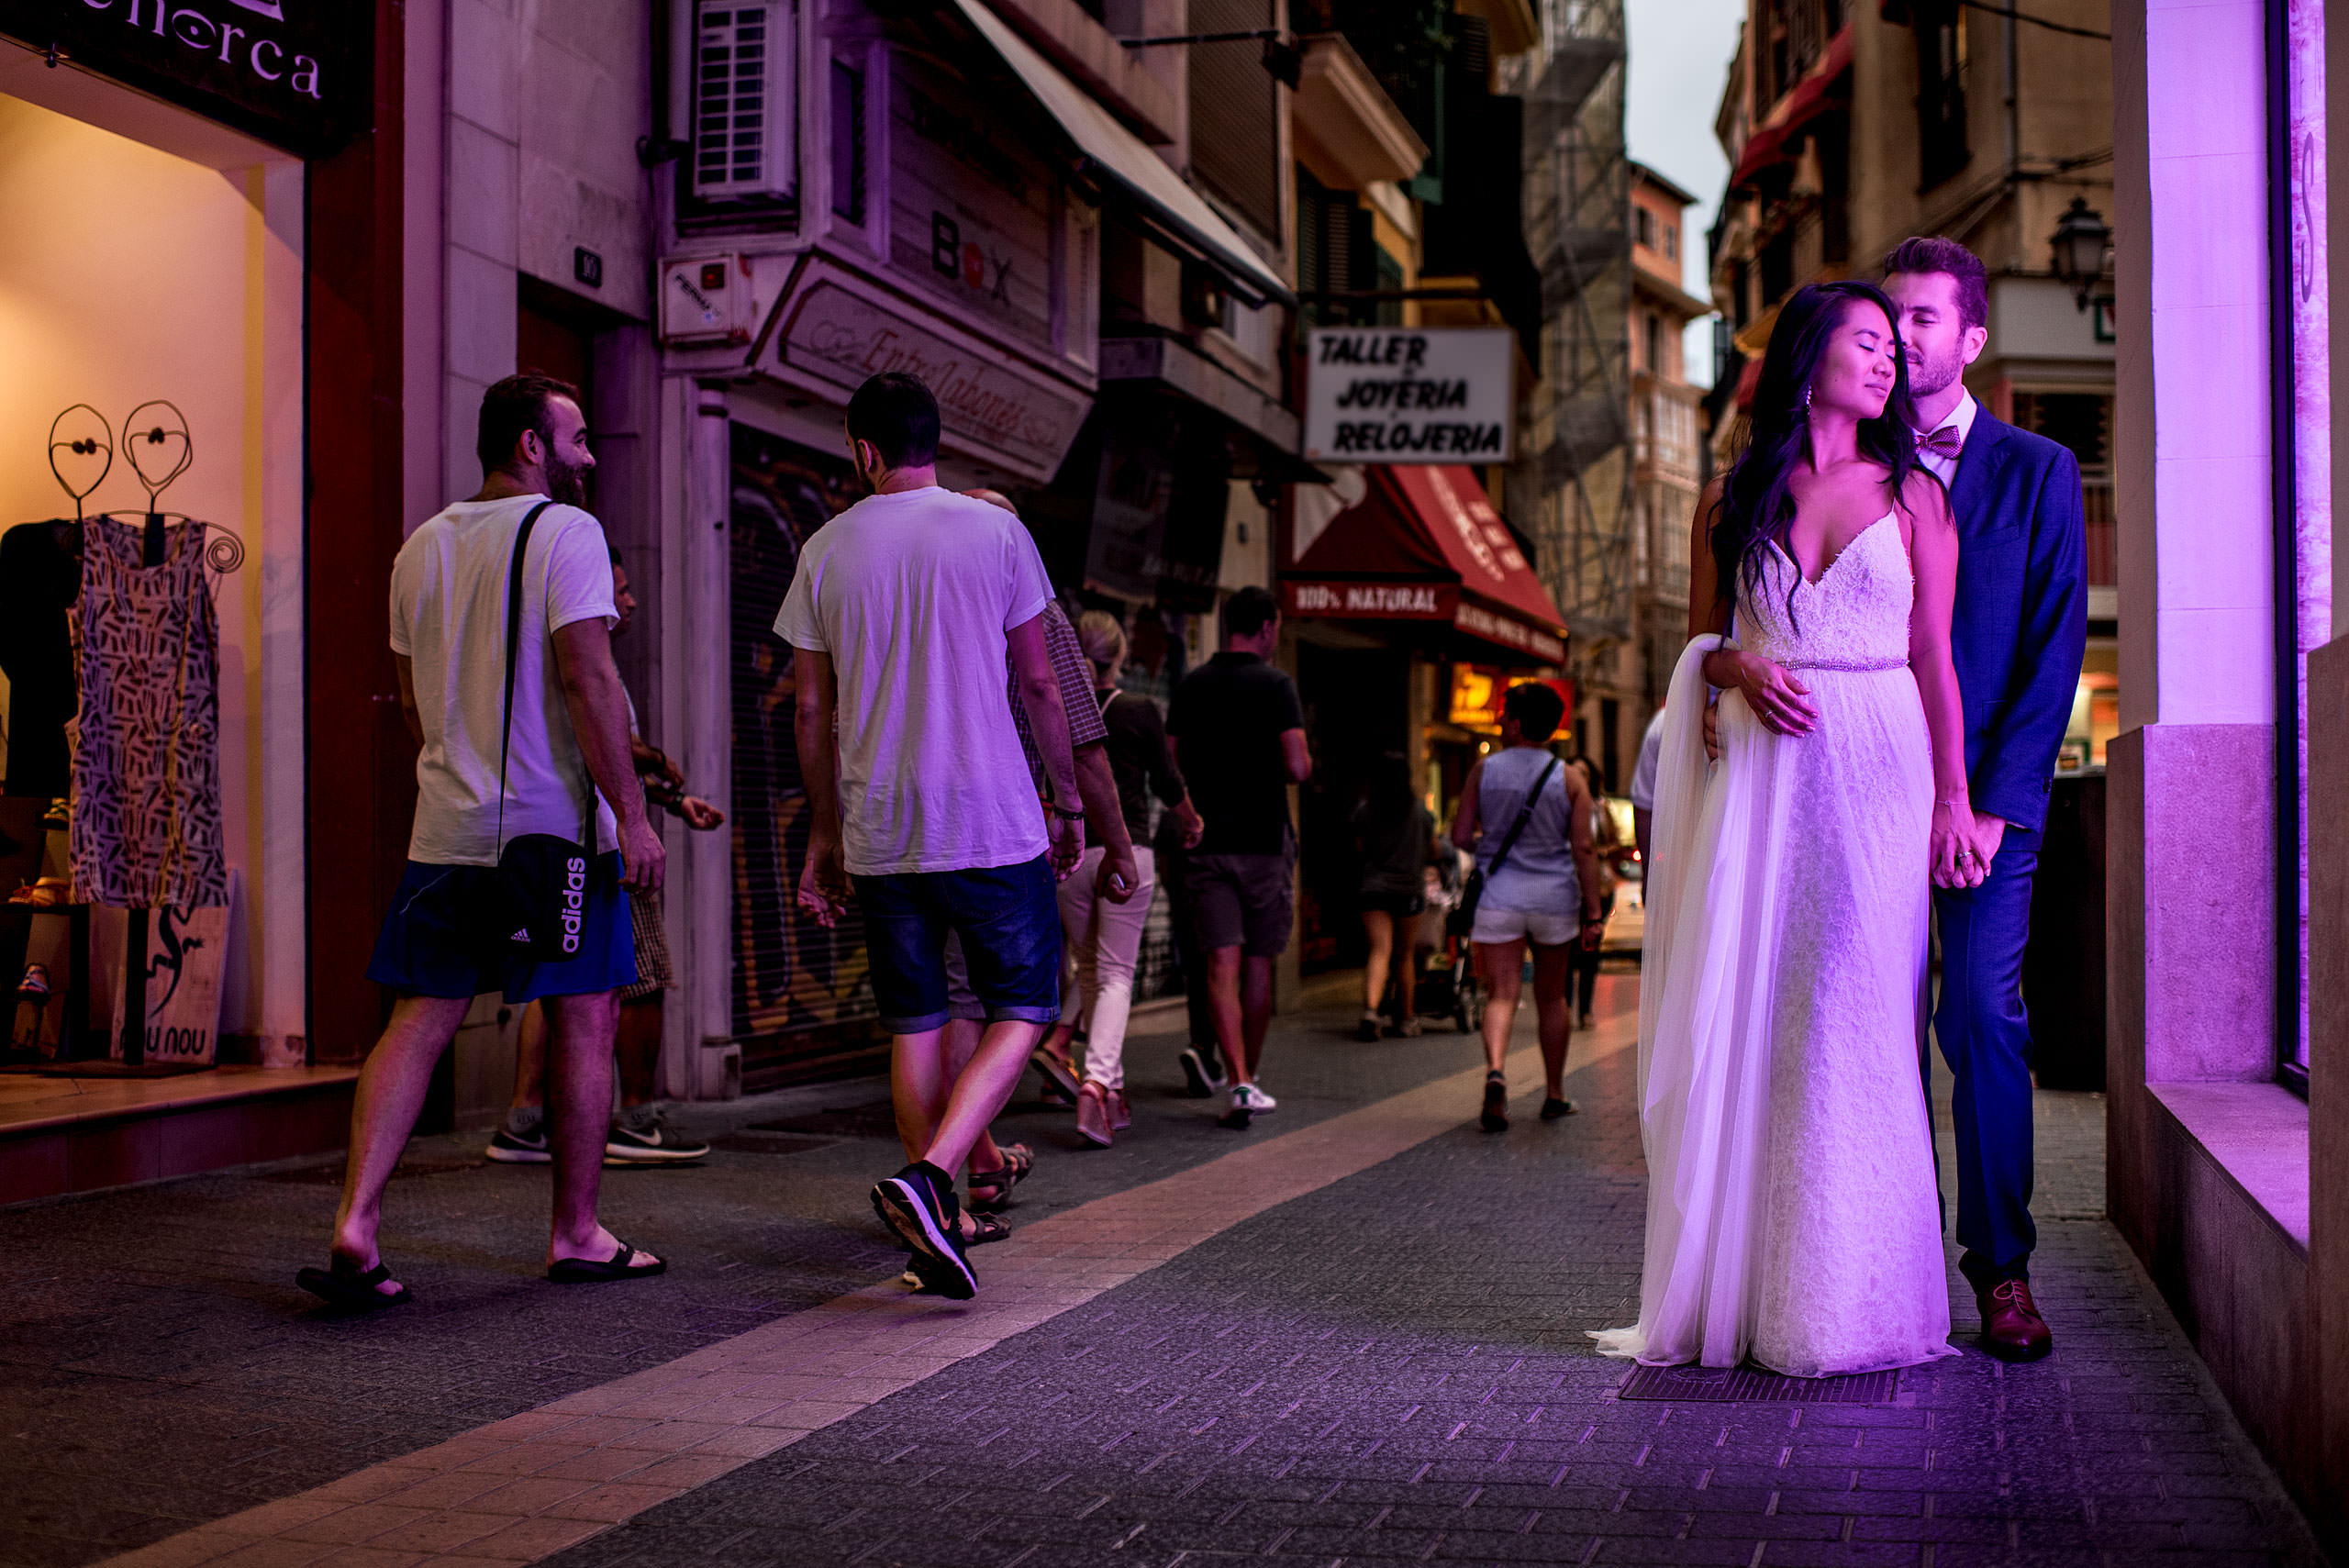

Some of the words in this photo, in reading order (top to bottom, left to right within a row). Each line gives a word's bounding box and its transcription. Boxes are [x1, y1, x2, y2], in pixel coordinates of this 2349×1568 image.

[81, 0, 322, 100] norca
[1319, 336, 1426, 365] TALLER
[1337, 379, 1466, 408] JOYERIA
[1334, 422, 1501, 454] RELOJERIA
[1345, 586, 1439, 614] NATURAL
[562, 857, 587, 953] adidas
